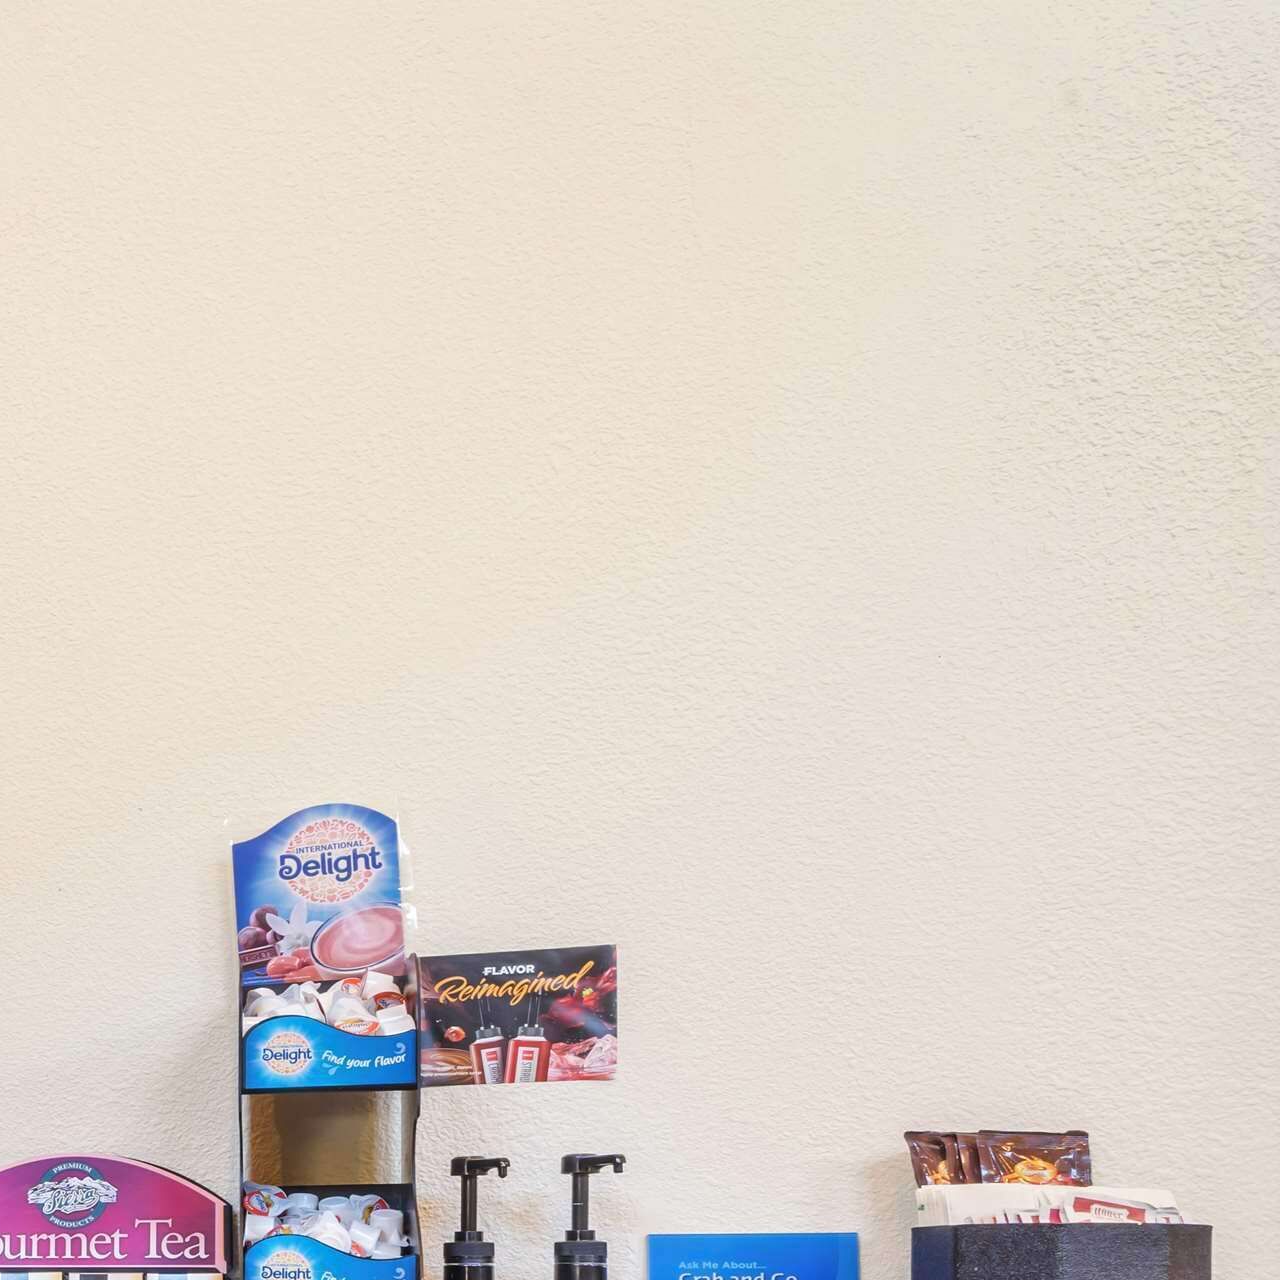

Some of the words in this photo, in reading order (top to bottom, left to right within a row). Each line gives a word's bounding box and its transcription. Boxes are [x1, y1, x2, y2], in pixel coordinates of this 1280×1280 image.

[295, 840, 364, 854] INTERNATIONAL
[278, 846, 383, 882] Delight
[482, 965, 535, 976] FLAVOR
[433, 960, 595, 1006] Reimagined
[262, 1048, 313, 1065] Delight
[322, 1050, 346, 1065] Find
[346, 1057, 371, 1069] your
[52, 1162, 92, 1173] PREMIUM
[43, 1188, 98, 1214] Sierra
[49, 1215, 95, 1228] PRODUCTS
[135, 1218, 209, 1260] Tea
[678, 1261, 699, 1269] Ask
[702, 1261, 719, 1269] Me
